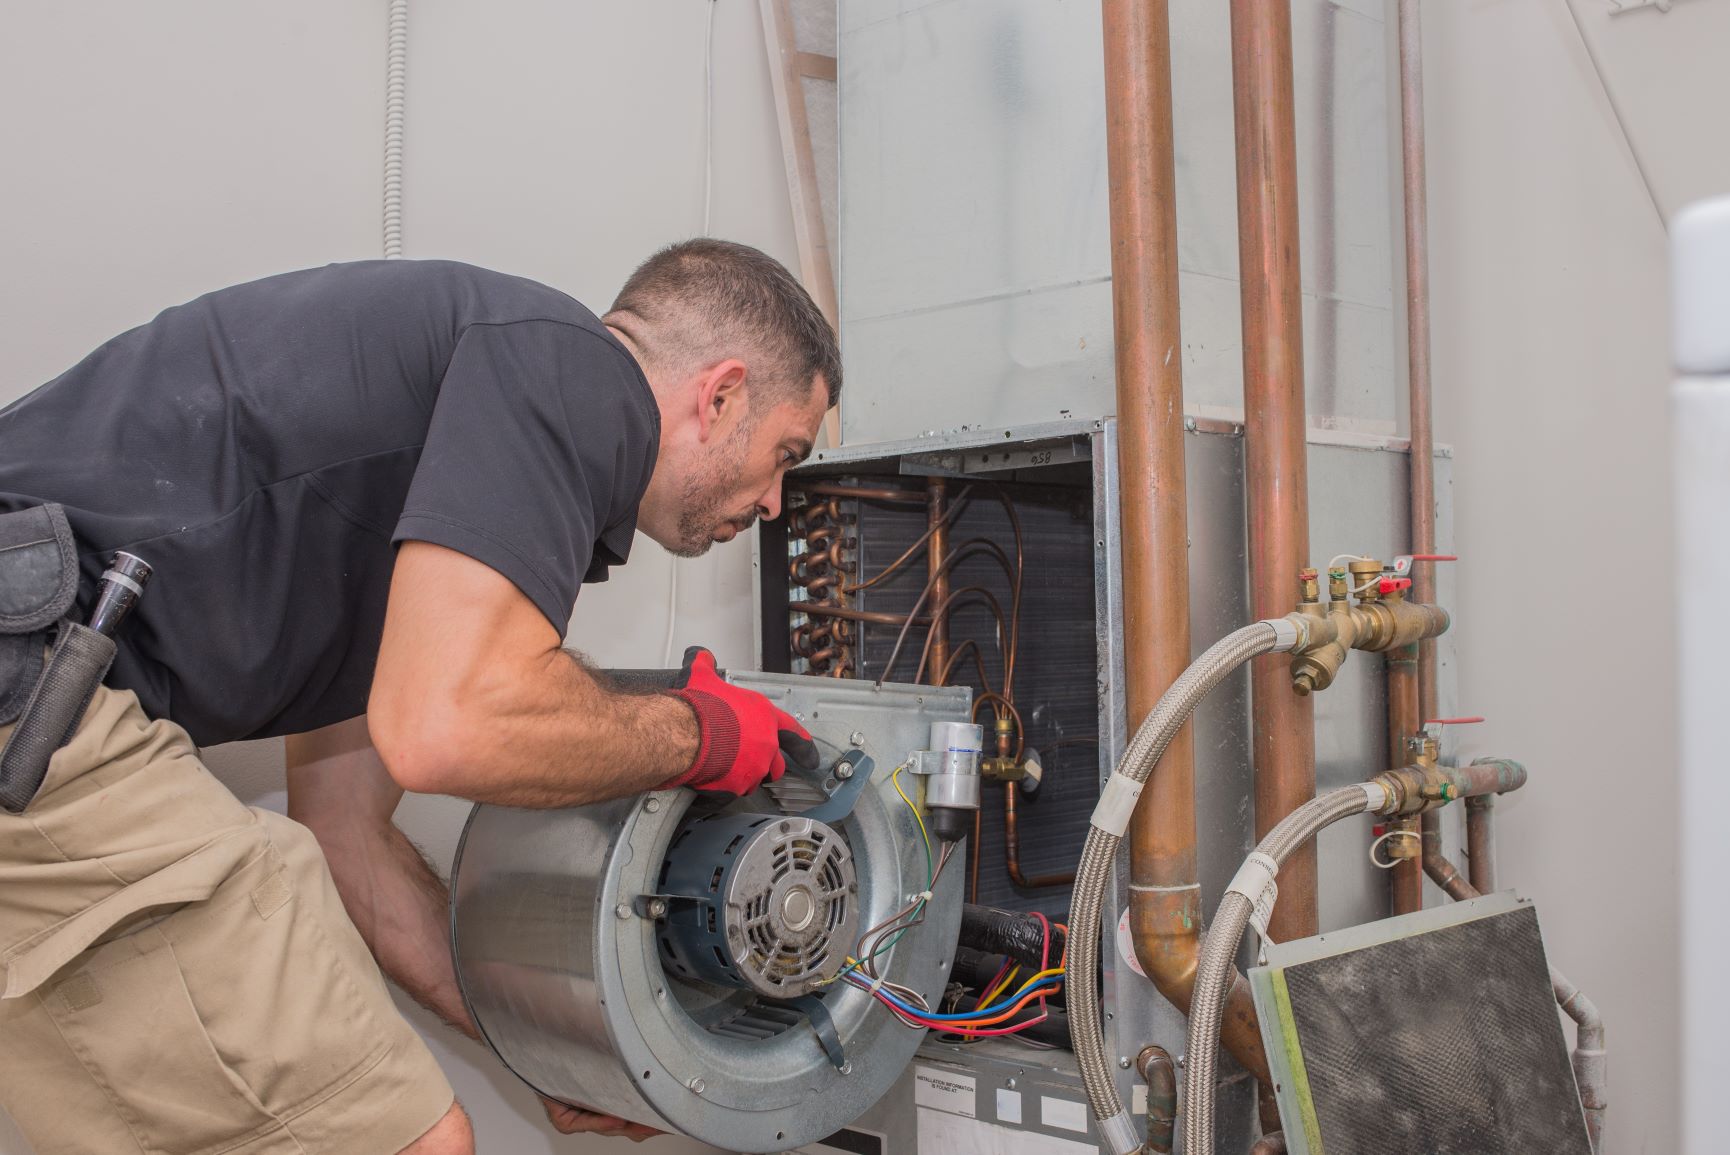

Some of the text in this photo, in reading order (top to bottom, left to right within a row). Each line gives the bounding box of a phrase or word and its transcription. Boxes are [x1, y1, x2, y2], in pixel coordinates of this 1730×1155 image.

[917, 1075, 974, 1092] INSTALLATION INFORMATION
[936, 1084, 951, 1092] FOUND
